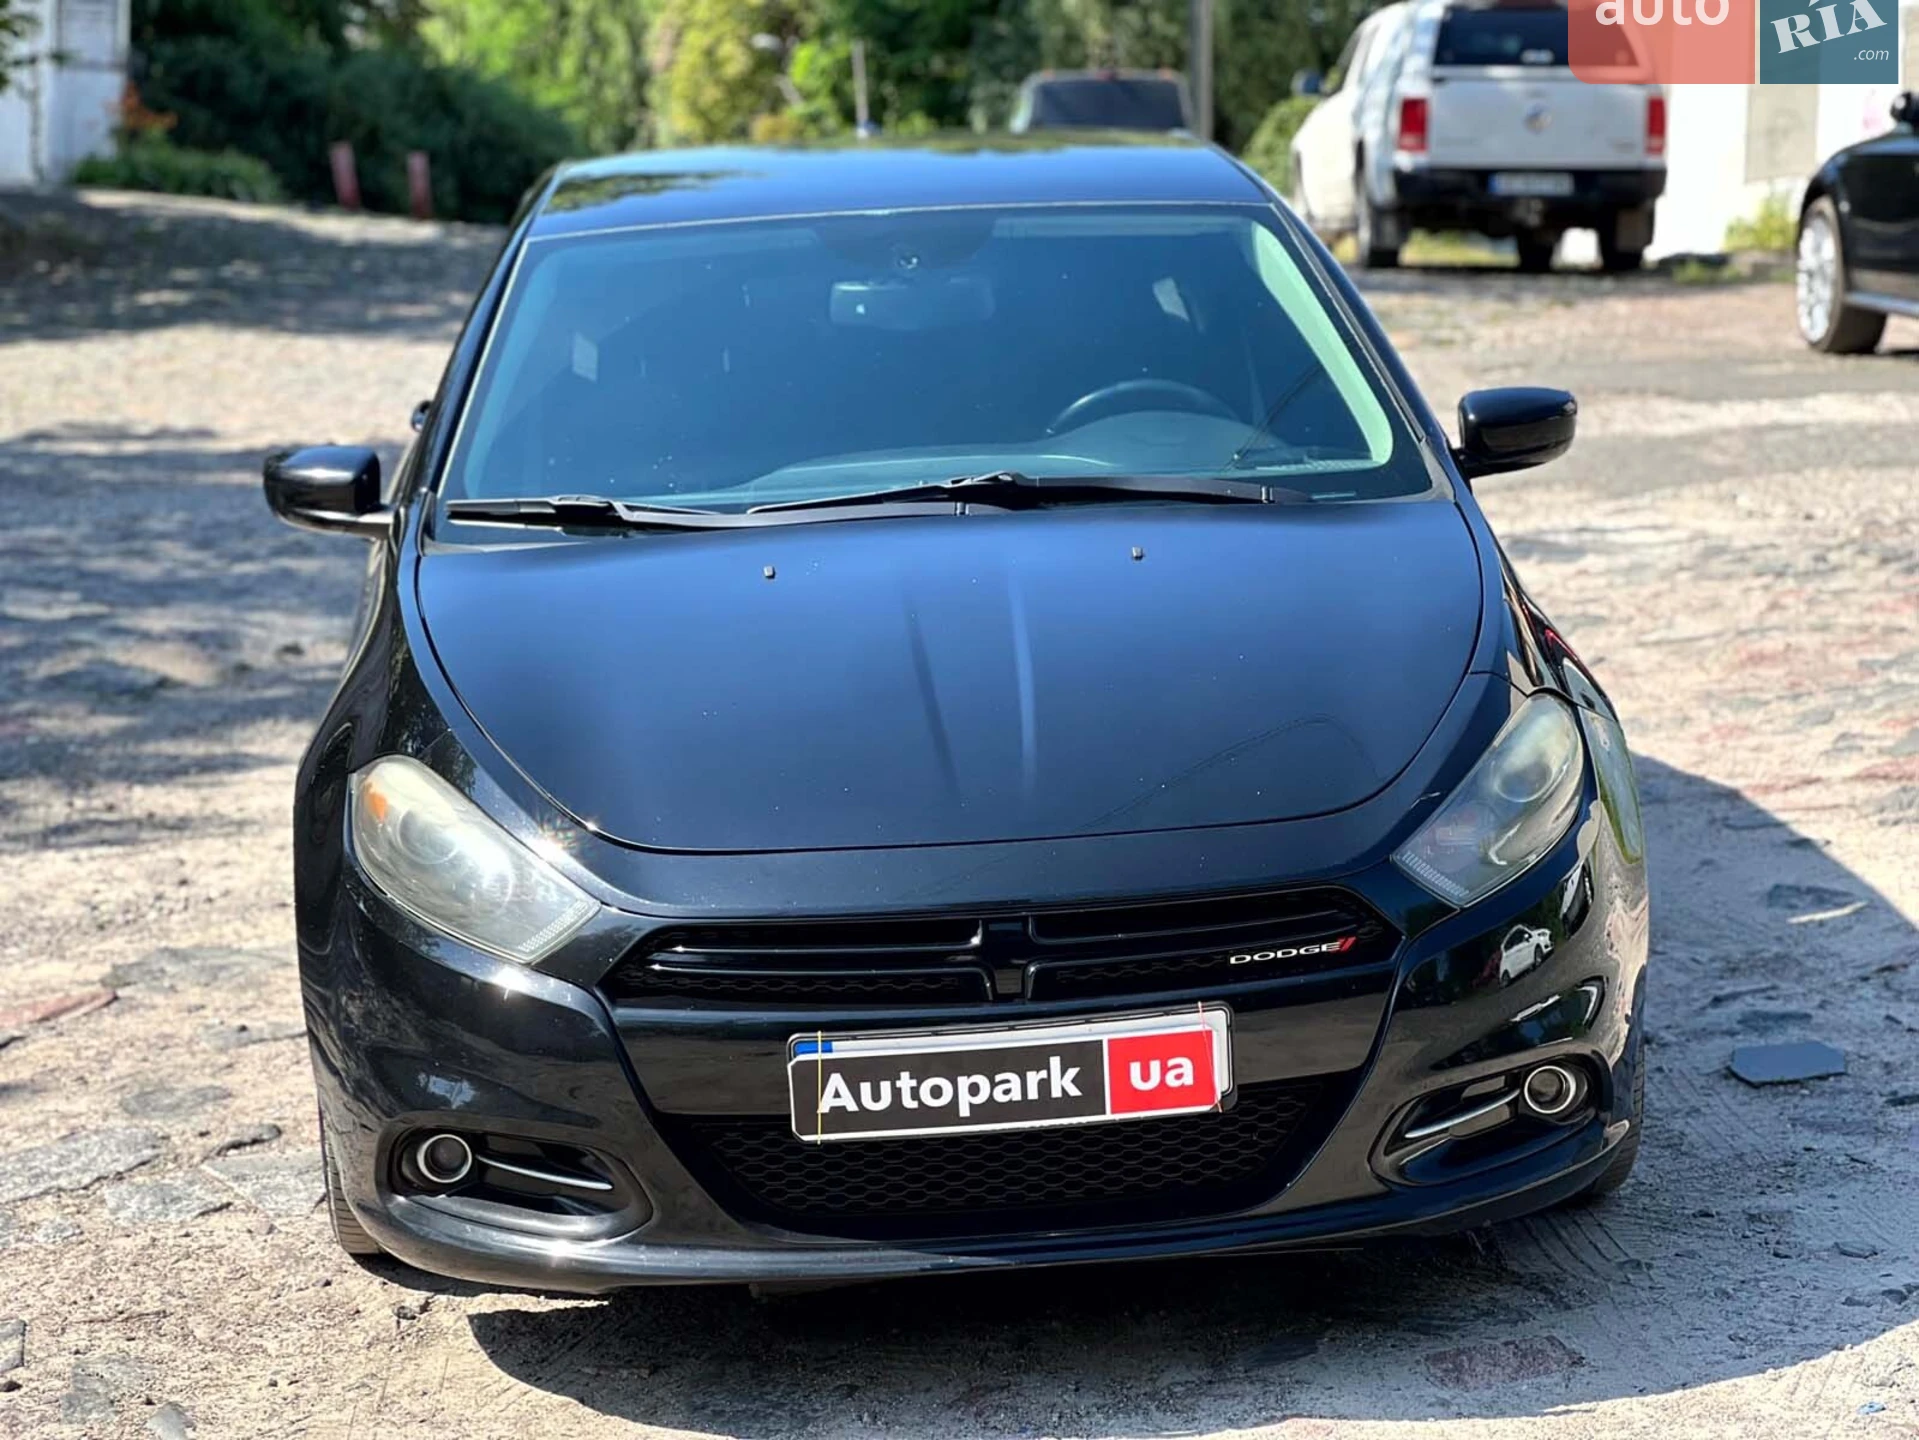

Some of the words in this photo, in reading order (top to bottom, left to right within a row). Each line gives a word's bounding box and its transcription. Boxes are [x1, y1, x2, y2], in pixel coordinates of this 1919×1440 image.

[1230, 941, 1342, 965] DODGE
[819, 1056, 1083, 1117] Autopark
[1129, 1055, 1194, 1092] ua
